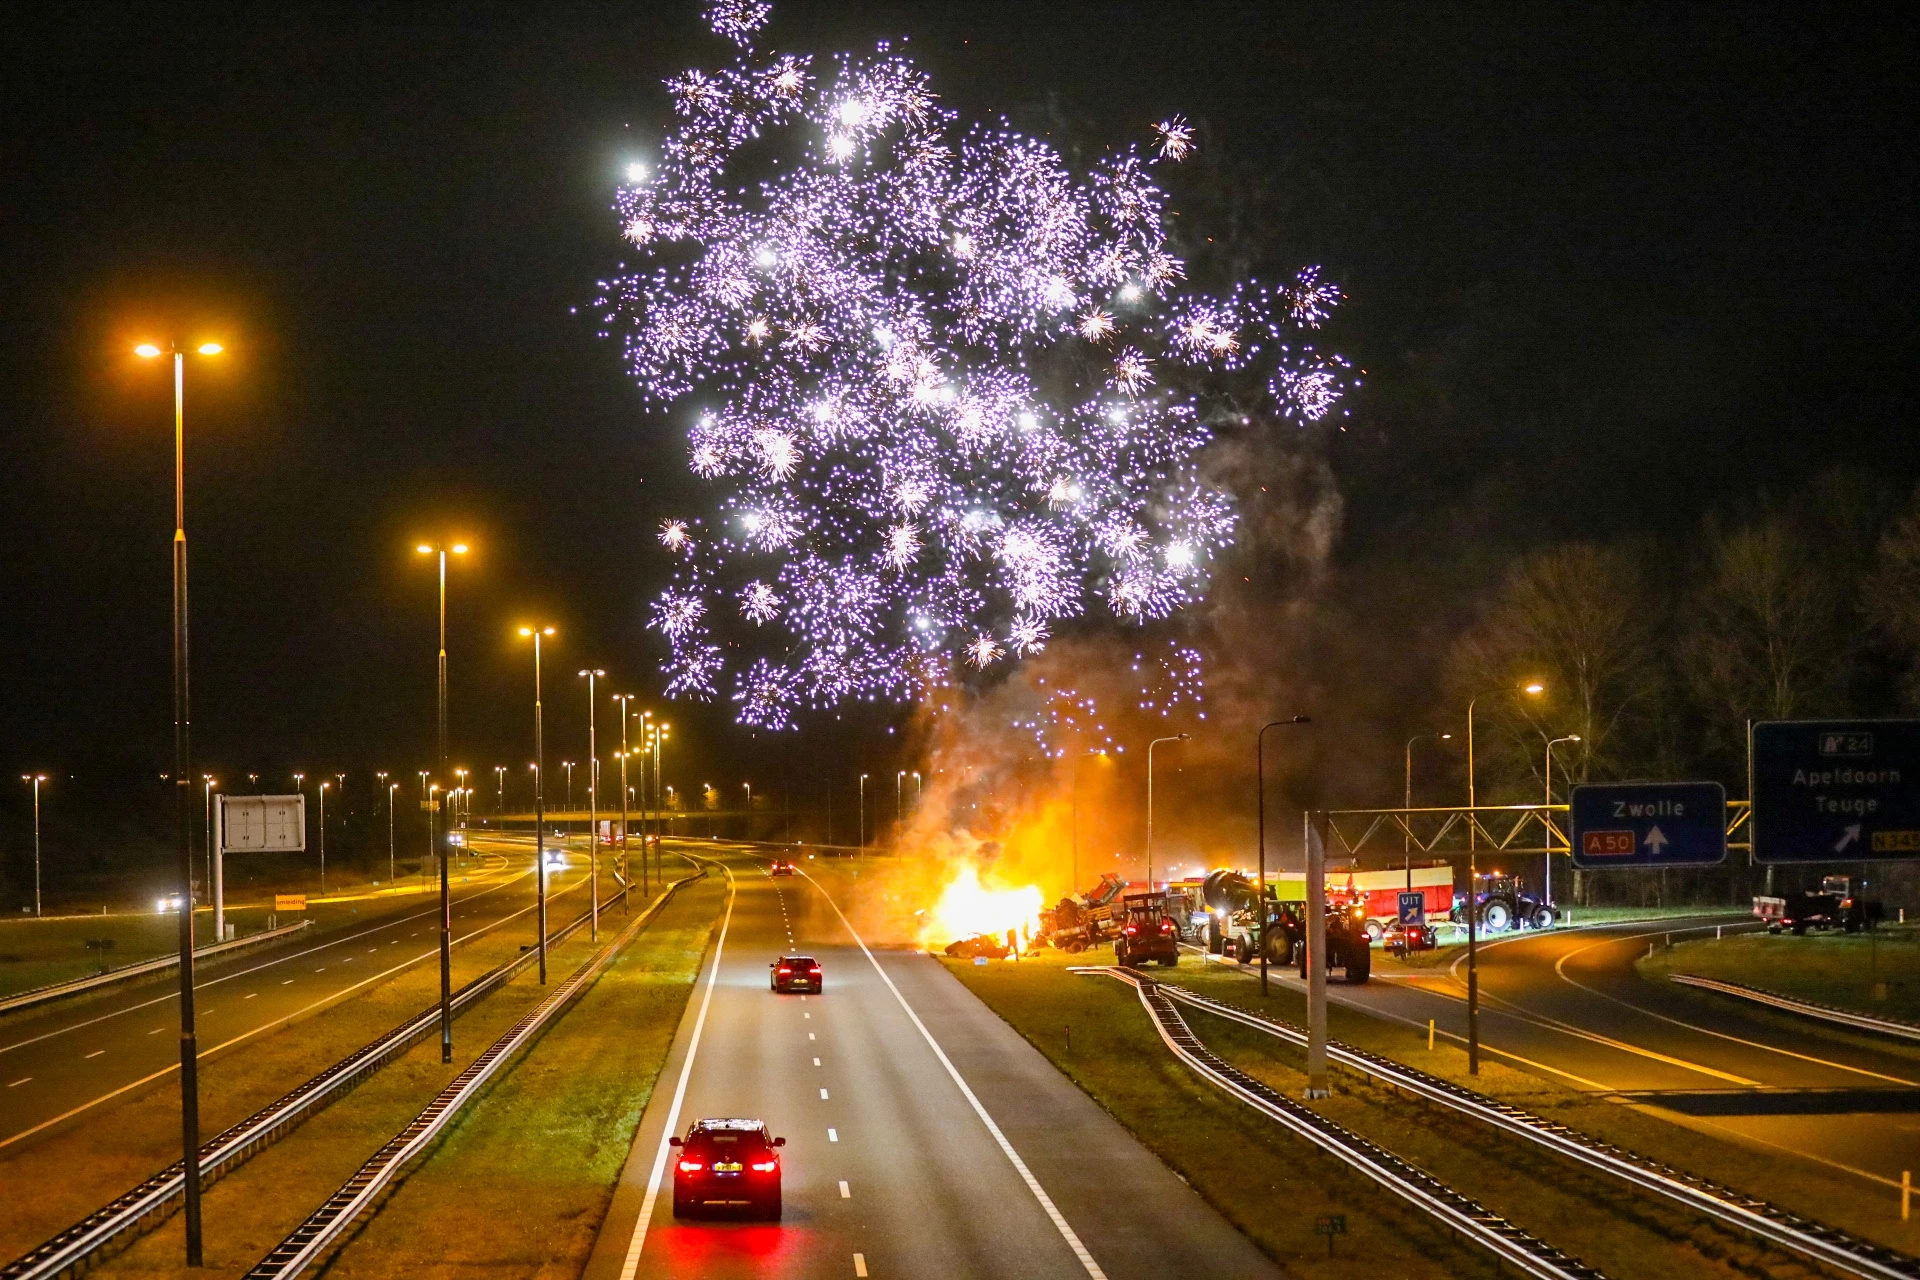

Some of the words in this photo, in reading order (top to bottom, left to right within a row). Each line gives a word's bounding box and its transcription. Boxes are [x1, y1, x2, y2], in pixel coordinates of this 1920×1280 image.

[1792, 767, 1901, 788] Apeldoorn
[1612, 800, 1685, 818] Zwolle
[1815, 794, 1879, 817] Teuge
[1401, 896, 1420, 905] UIT
